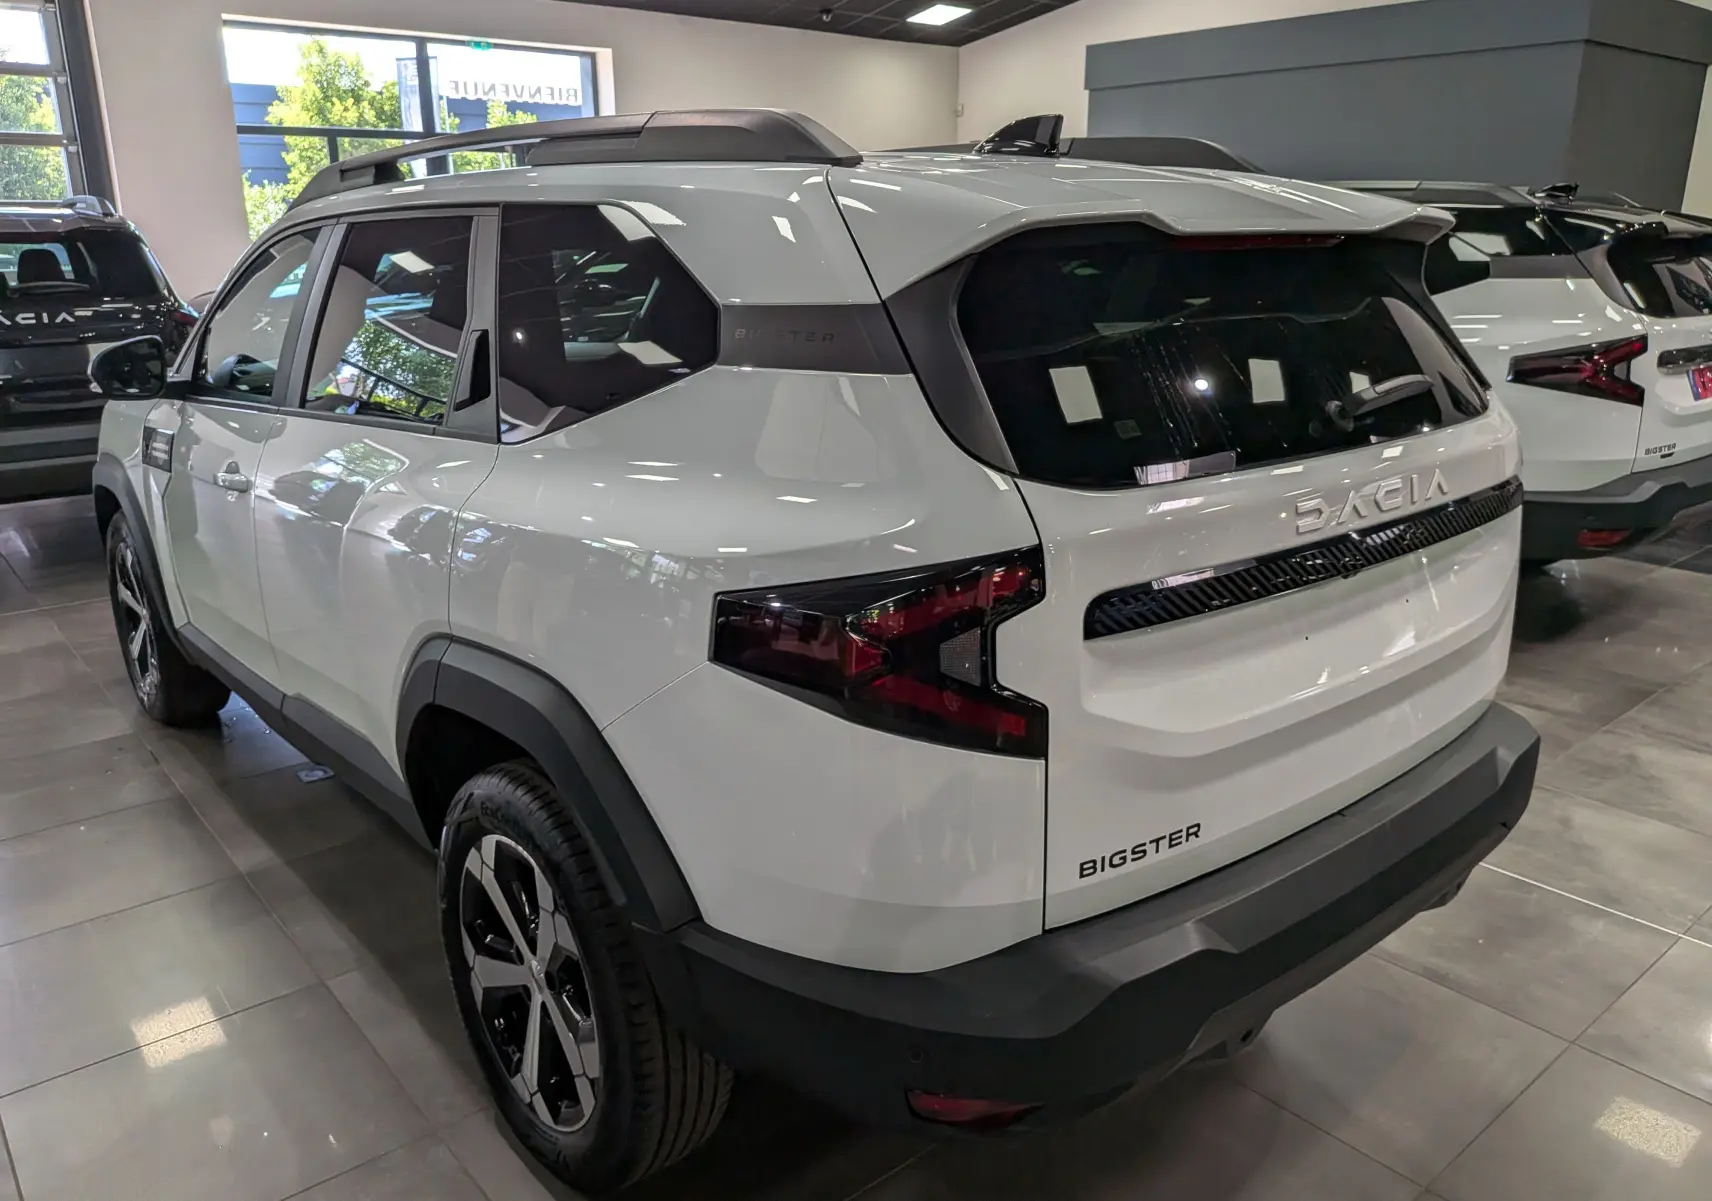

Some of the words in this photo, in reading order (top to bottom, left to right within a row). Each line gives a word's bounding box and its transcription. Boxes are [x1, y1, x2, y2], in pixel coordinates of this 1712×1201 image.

[0, 310, 76, 326] ACIA
[1644, 442, 1677, 456] BIGSTER
[1295, 468, 1449, 535] DACIA
[1078, 822, 1202, 880] BIGSTER
